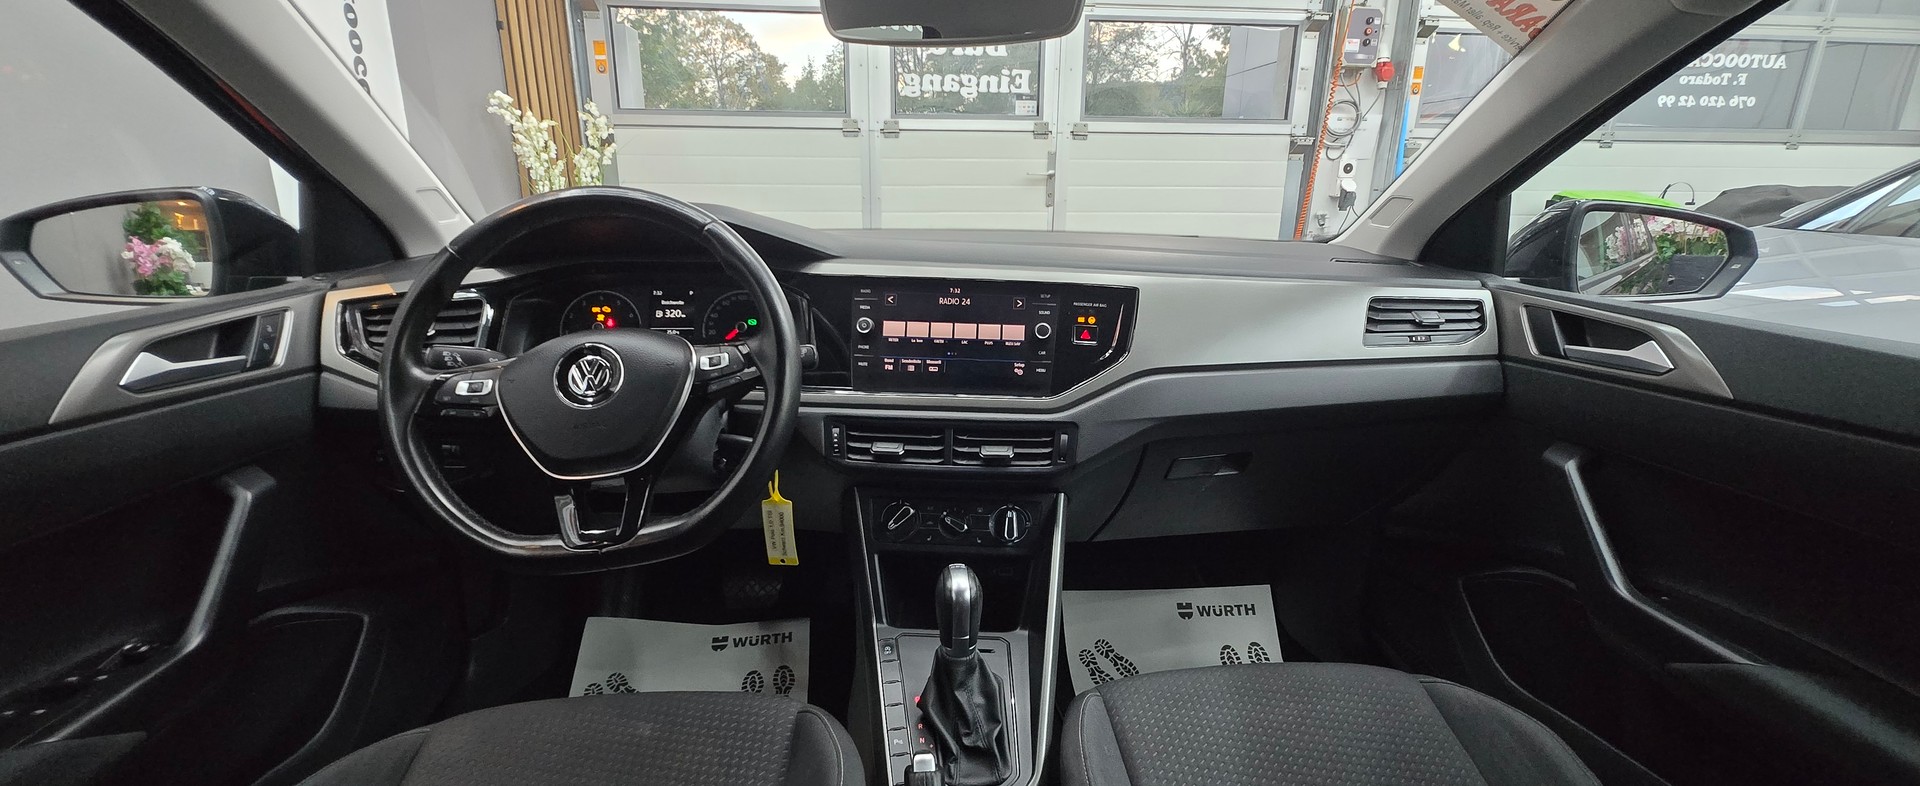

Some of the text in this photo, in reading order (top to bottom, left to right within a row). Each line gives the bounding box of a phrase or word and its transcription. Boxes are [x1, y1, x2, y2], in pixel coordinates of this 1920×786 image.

[938, 297, 971, 306] RADIO 24
[664, 309, 682, 318] 320
[1196, 603, 1256, 617] WÜRTH
[732, 631, 793, 648] WÜRTH
